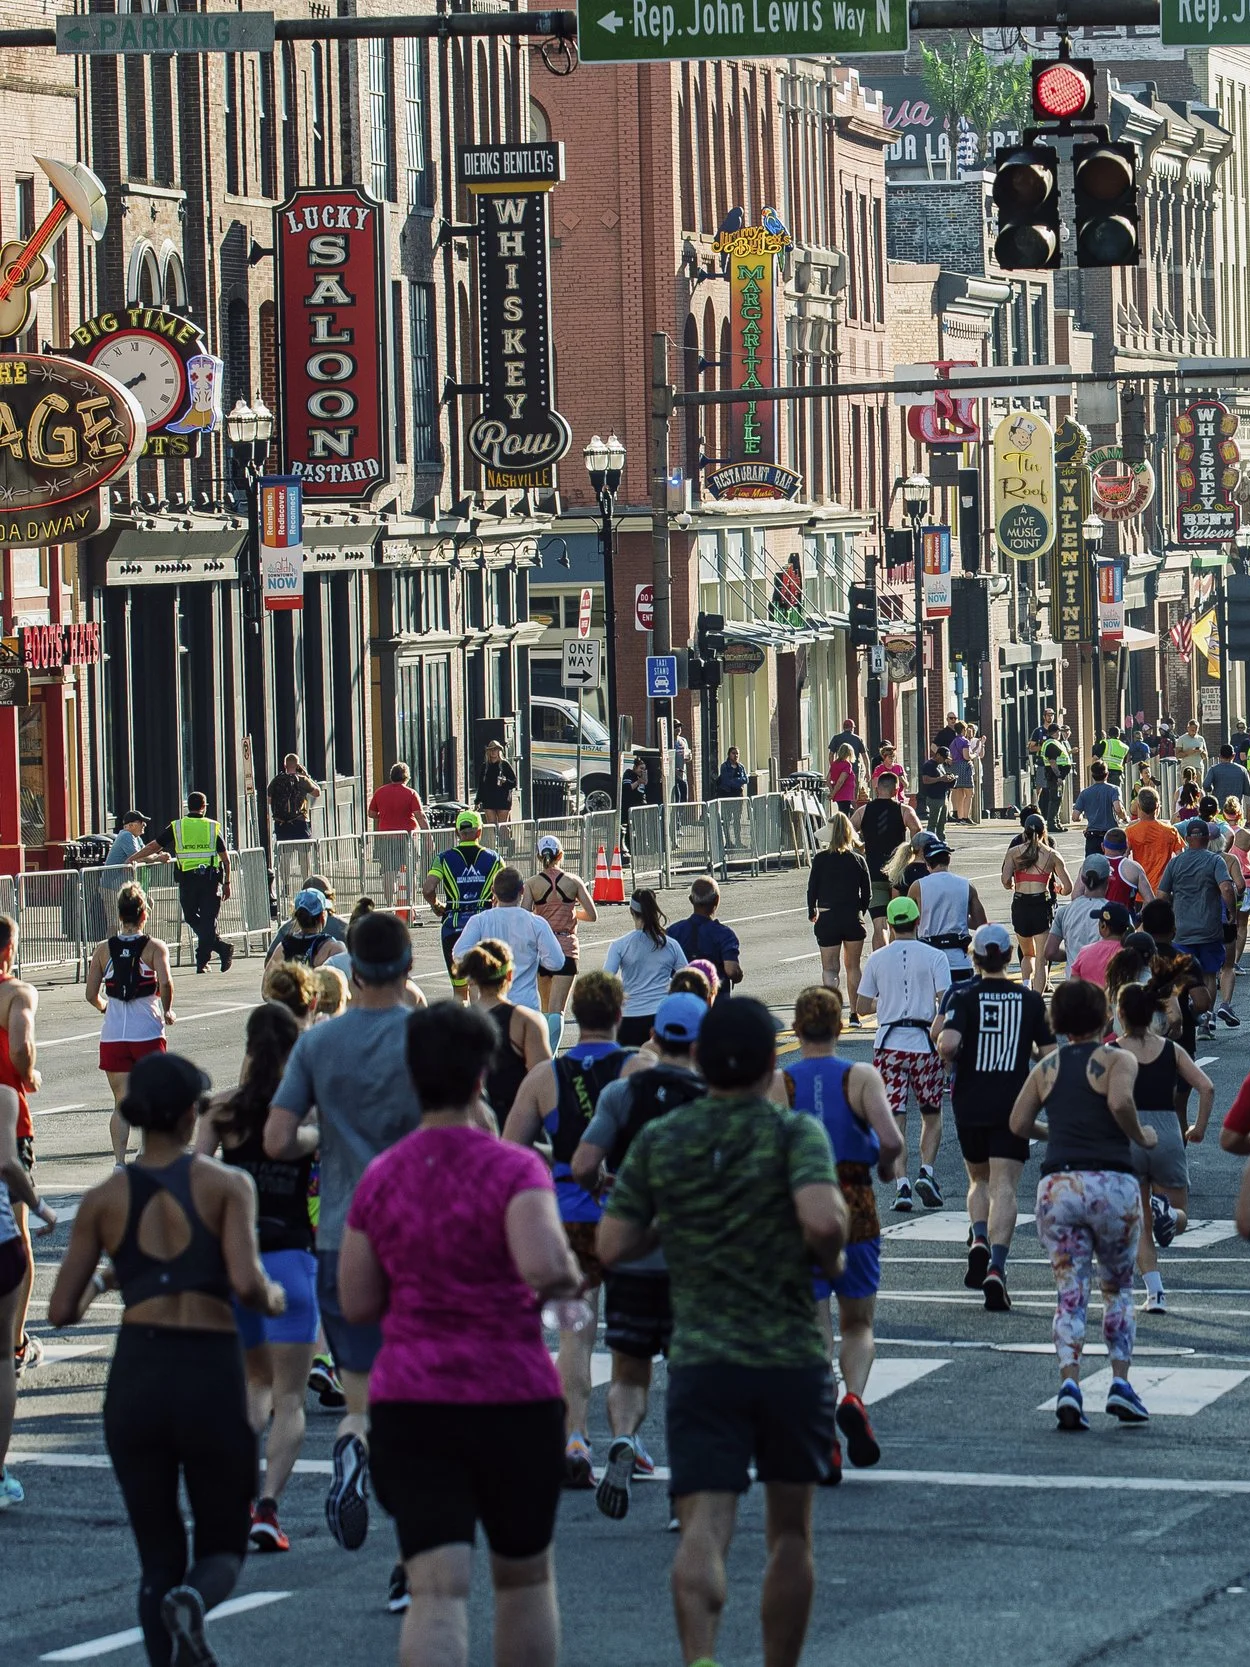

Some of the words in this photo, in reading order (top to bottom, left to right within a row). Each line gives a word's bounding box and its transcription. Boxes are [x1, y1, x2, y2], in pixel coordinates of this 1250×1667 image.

[634, 0, 682, 46] Rep.
[687, 0, 745, 35] John
[753, 0, 822, 33] Lewis
[833, 1, 865, 37] Way
[876, 0, 891, 33] N
[1178, 0, 1228, 33] Rep.
[102, 18, 230, 47] PARKING
[464, 153, 500, 176] DIERKS
[285, 205, 371, 234] LUCKY
[492, 199, 528, 419] WHISKEY
[75, 313, 118, 346] BIG
[128, 309, 196, 345] TIME
[305, 235, 355, 458] SALOON
[737, 265, 764, 454] MARGARITAILLE
[479, 420, 553, 468] Row
[291, 457, 380, 484] BASTARD
[1003, 452, 1041, 474] Tin
[1197, 408, 1217, 510] WHISKEY
[487, 467, 550, 490] NASHVILLE
[713, 467, 770, 491] RESTAURANT
[775, 468, 793, 488] BAR
[1061, 467, 1076, 476] the
[731, 488, 750, 499] Live
[751, 486, 776, 498] Music
[998, 477, 1048, 504] Roof
[278, 488, 286, 537] Rediscover.
[289, 490, 297, 536] Reconnect.
[1013, 516, 1036, 526] LIVE
[1019, 505, 1028, 514] A
[1183, 512, 1235, 526] BENT
[1006, 527, 1042, 538] MUSIC
[1009, 538, 1041, 549] JOINT
[1183, 525, 1235, 541] Saloon
[1059, 478, 1080, 641] VALENTINE
[267, 577, 297, 590] NOW
[640, 593, 649, 602] DO
[927, 594, 947, 603] NOW
[643, 613, 654, 622] ENT
[1103, 620, 1121, 628] NOW
[70, 621, 100, 666] HATS
[569, 643, 594, 655] ONE
[567, 656, 594, 667] WAY
[654, 668, 670, 676] STAND
[978, 991, 1023, 1001] FREEDOM
